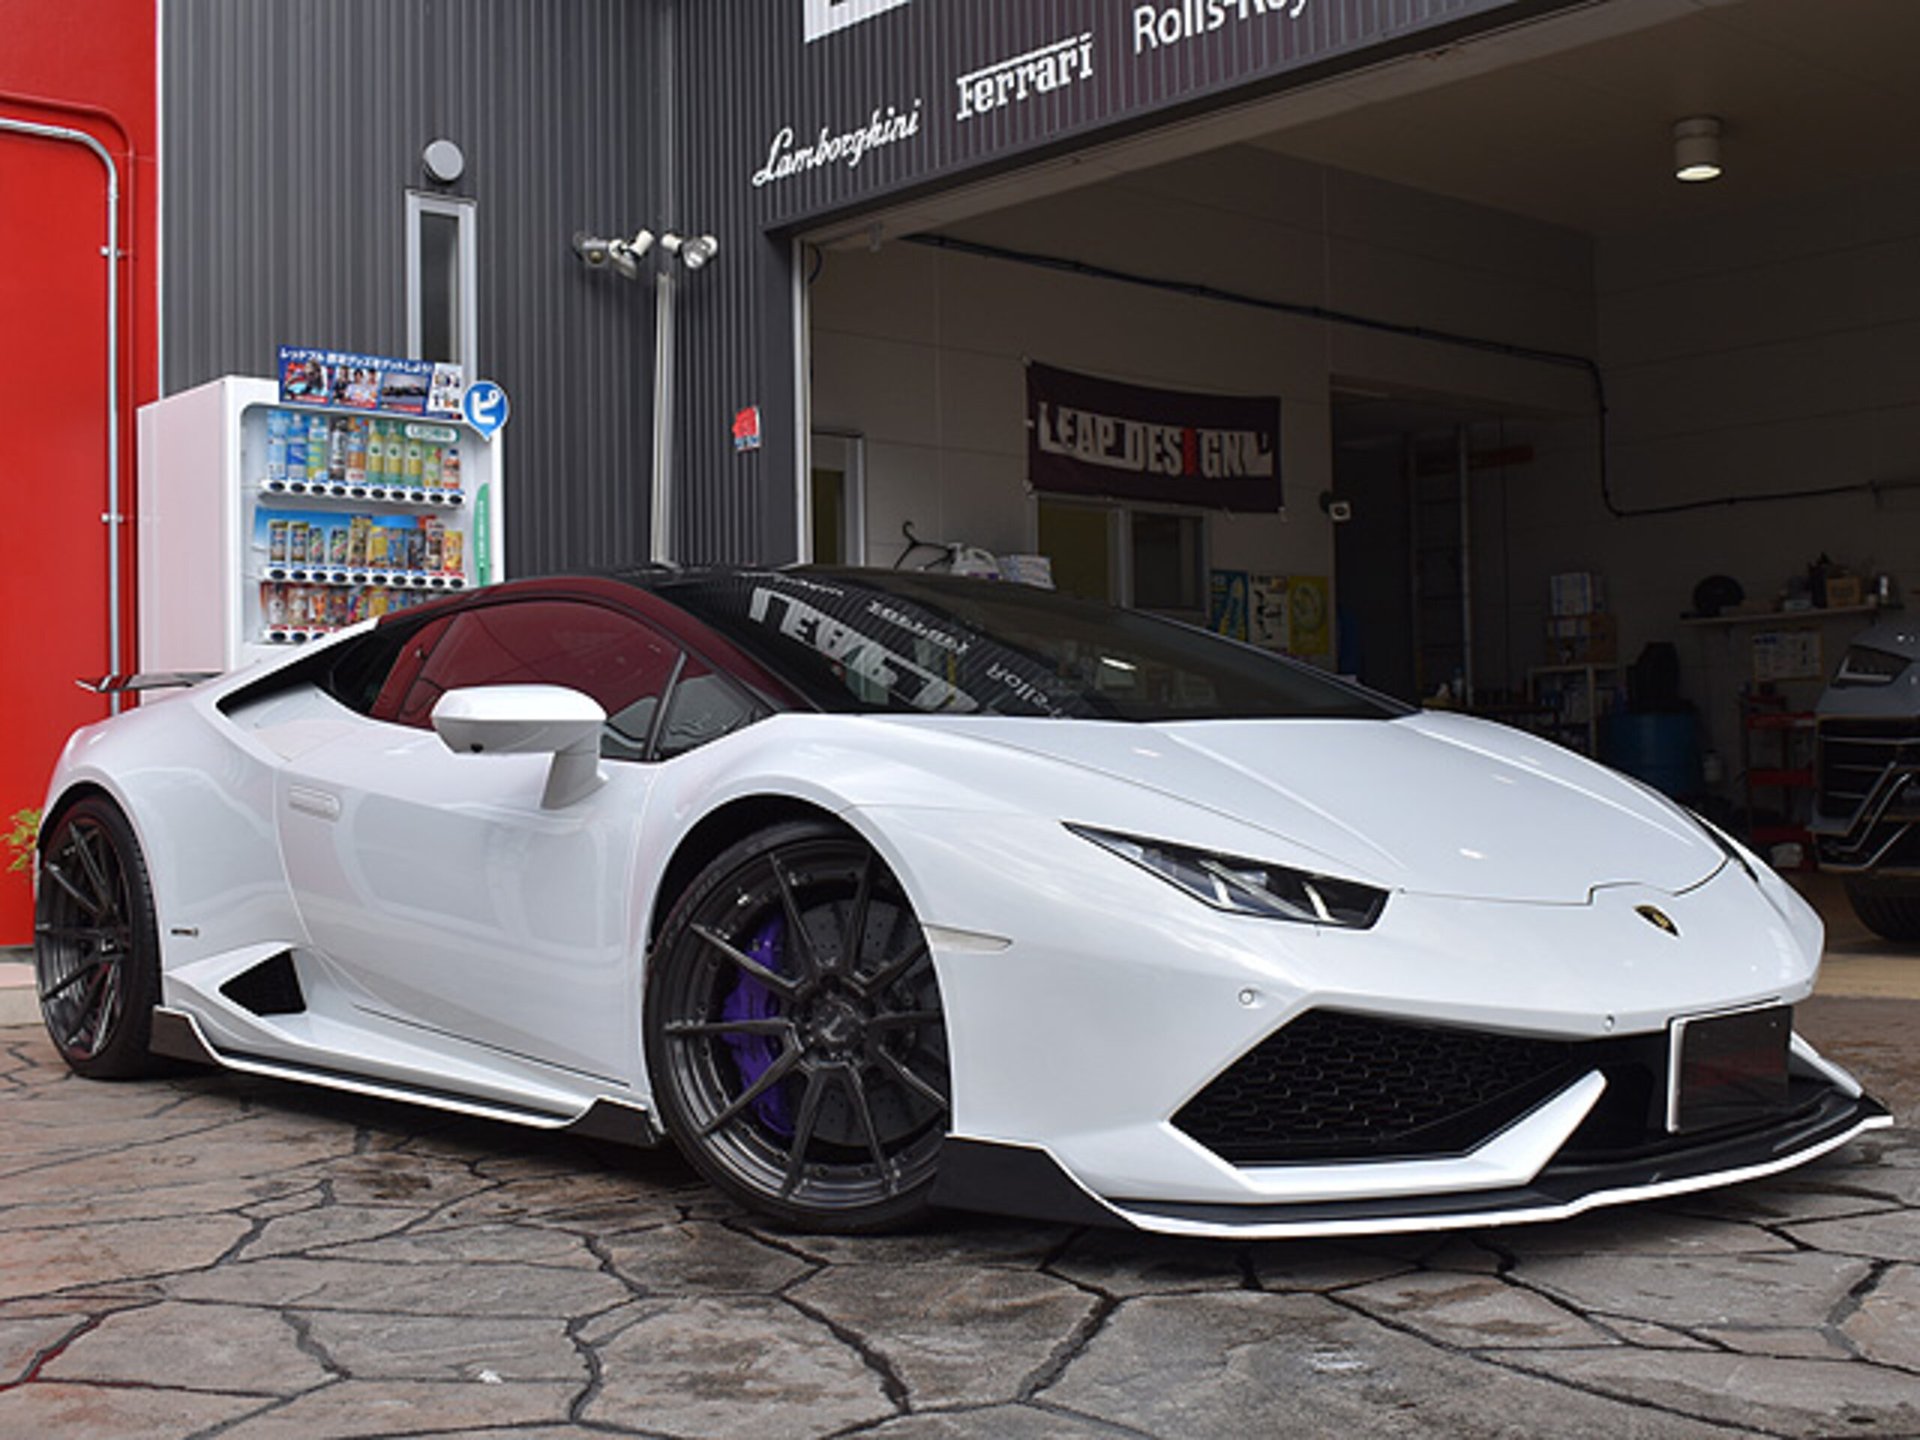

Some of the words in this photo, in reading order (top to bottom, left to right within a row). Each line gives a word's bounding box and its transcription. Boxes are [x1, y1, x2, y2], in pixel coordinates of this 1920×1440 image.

[957, 33, 1094, 121] Ferrari
[752, 99, 920, 188] Lamborghini
[1038, 402, 1118, 470] LEAP
